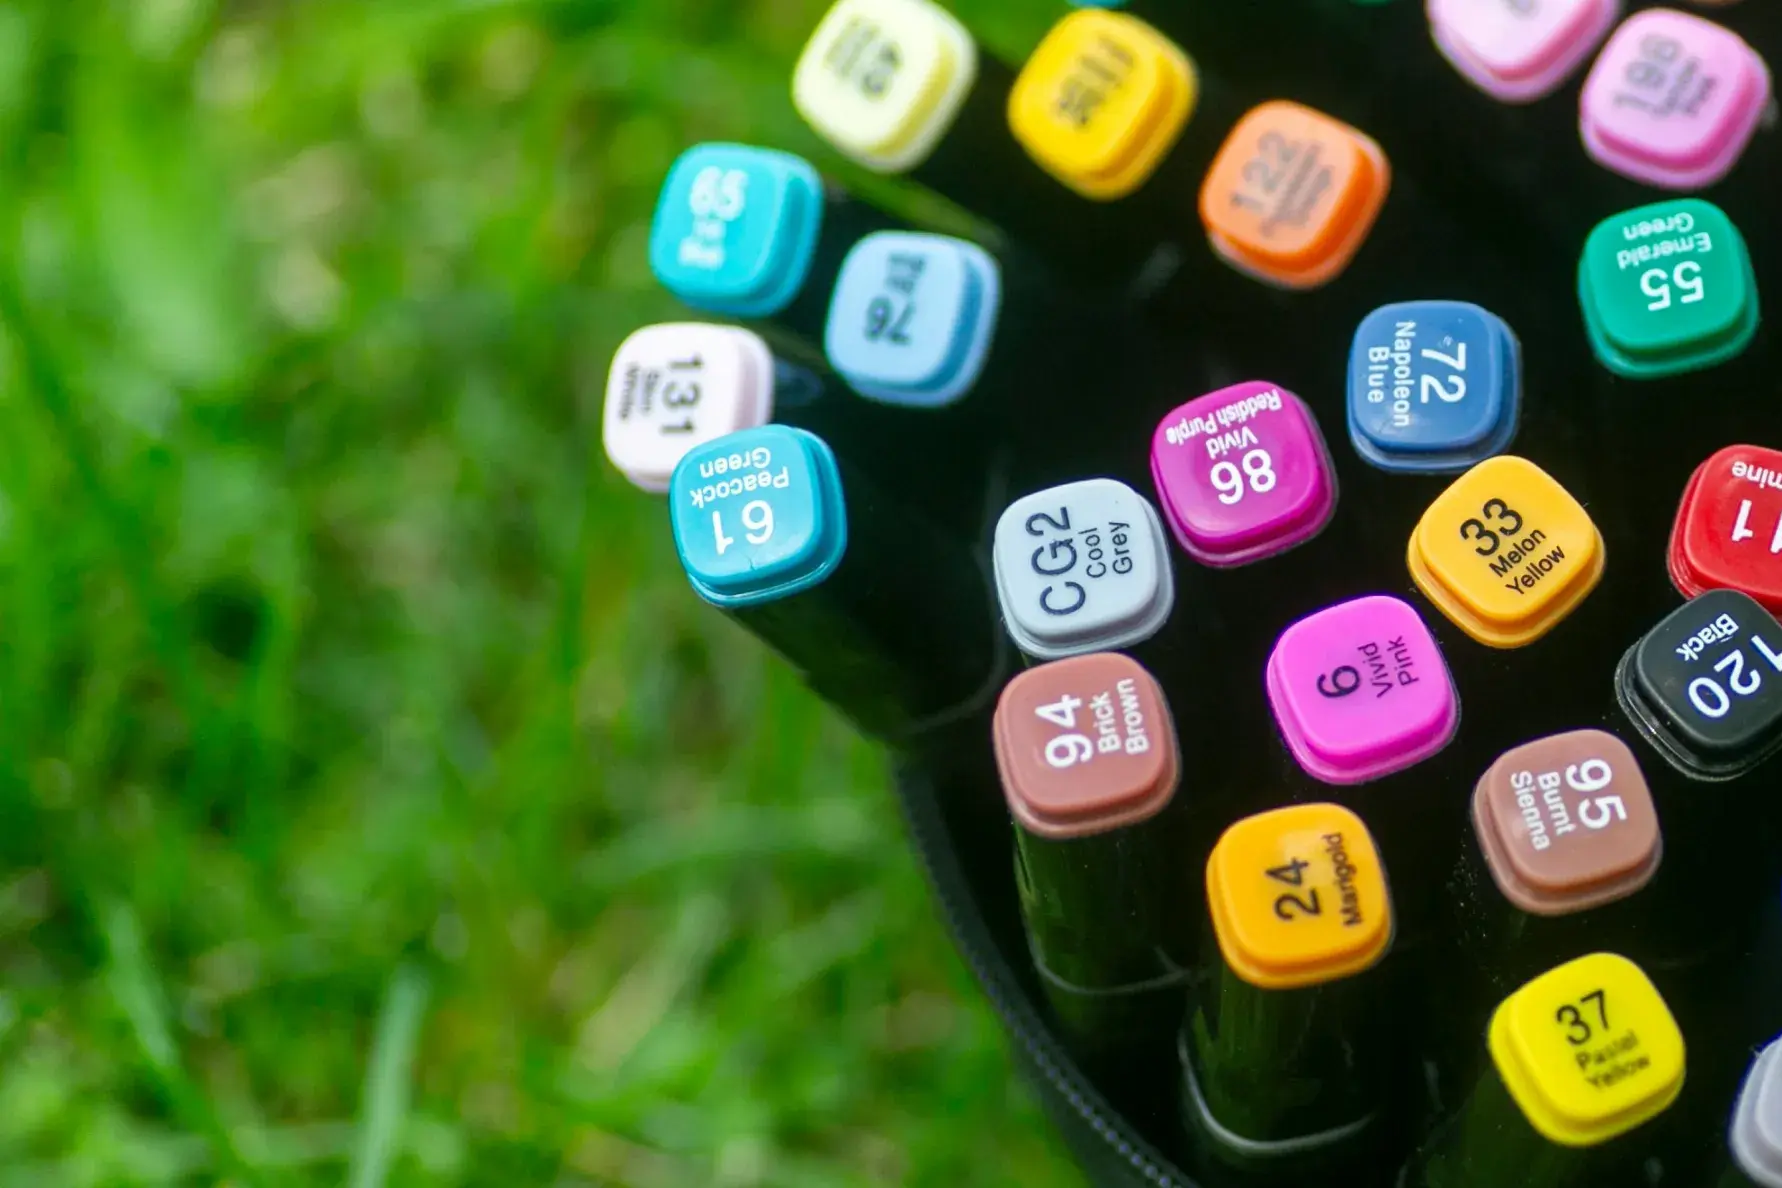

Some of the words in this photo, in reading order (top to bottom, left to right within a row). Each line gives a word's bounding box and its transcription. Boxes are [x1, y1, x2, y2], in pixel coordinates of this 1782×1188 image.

[689, 165, 748, 222] 65
[1229, 130, 1297, 211] 122
[1616, 231, 1713, 270] Emerald
[1623, 211, 1695, 241] Green
[1640, 260, 1705, 312] 55
[864, 296, 916, 345] 76
[660, 354, 704, 435] 131
[1367, 346, 1390, 404] Blue
[1390, 320, 1417, 427] Napoleon
[1420, 342, 1467, 404] 72
[1165, 412, 1218, 446] Purple
[1216, 388, 1282, 428] Reddish
[700, 446, 771, 478] Green
[1205, 425, 1259, 461] Vivid
[689, 466, 790, 509] Peacock
[1210, 449, 1277, 505] 86
[712, 499, 774, 556] 61
[1078, 527, 1107, 579] Cool
[1108, 521, 1133, 575] Grey
[1460, 497, 1523, 557] 33
[1488, 528, 1547, 578] Melon
[1025, 505, 1086, 616] CG2
[1505, 545, 1566, 596] Yellow
[1387, 635, 1420, 686] Pink
[1675, 613, 1739, 662] Black
[1316, 665, 1360, 698] 6
[1357, 641, 1393, 698] Vivid
[1035, 694, 1093, 768] 94
[1089, 691, 1121, 753] Brick
[1116, 678, 1149, 755] Brown
[1510, 769, 1550, 851] Sienna
[1537, 771, 1576, 836] Burnt
[1565, 759, 1628, 829] 95
[1264, 856, 1322, 921] 24
[1321, 832, 1363, 927] Marigold
[1556, 988, 1609, 1045] 37
[1575, 1028, 1639, 1071] Pastel
[1585, 1055, 1651, 1090] Yellow
